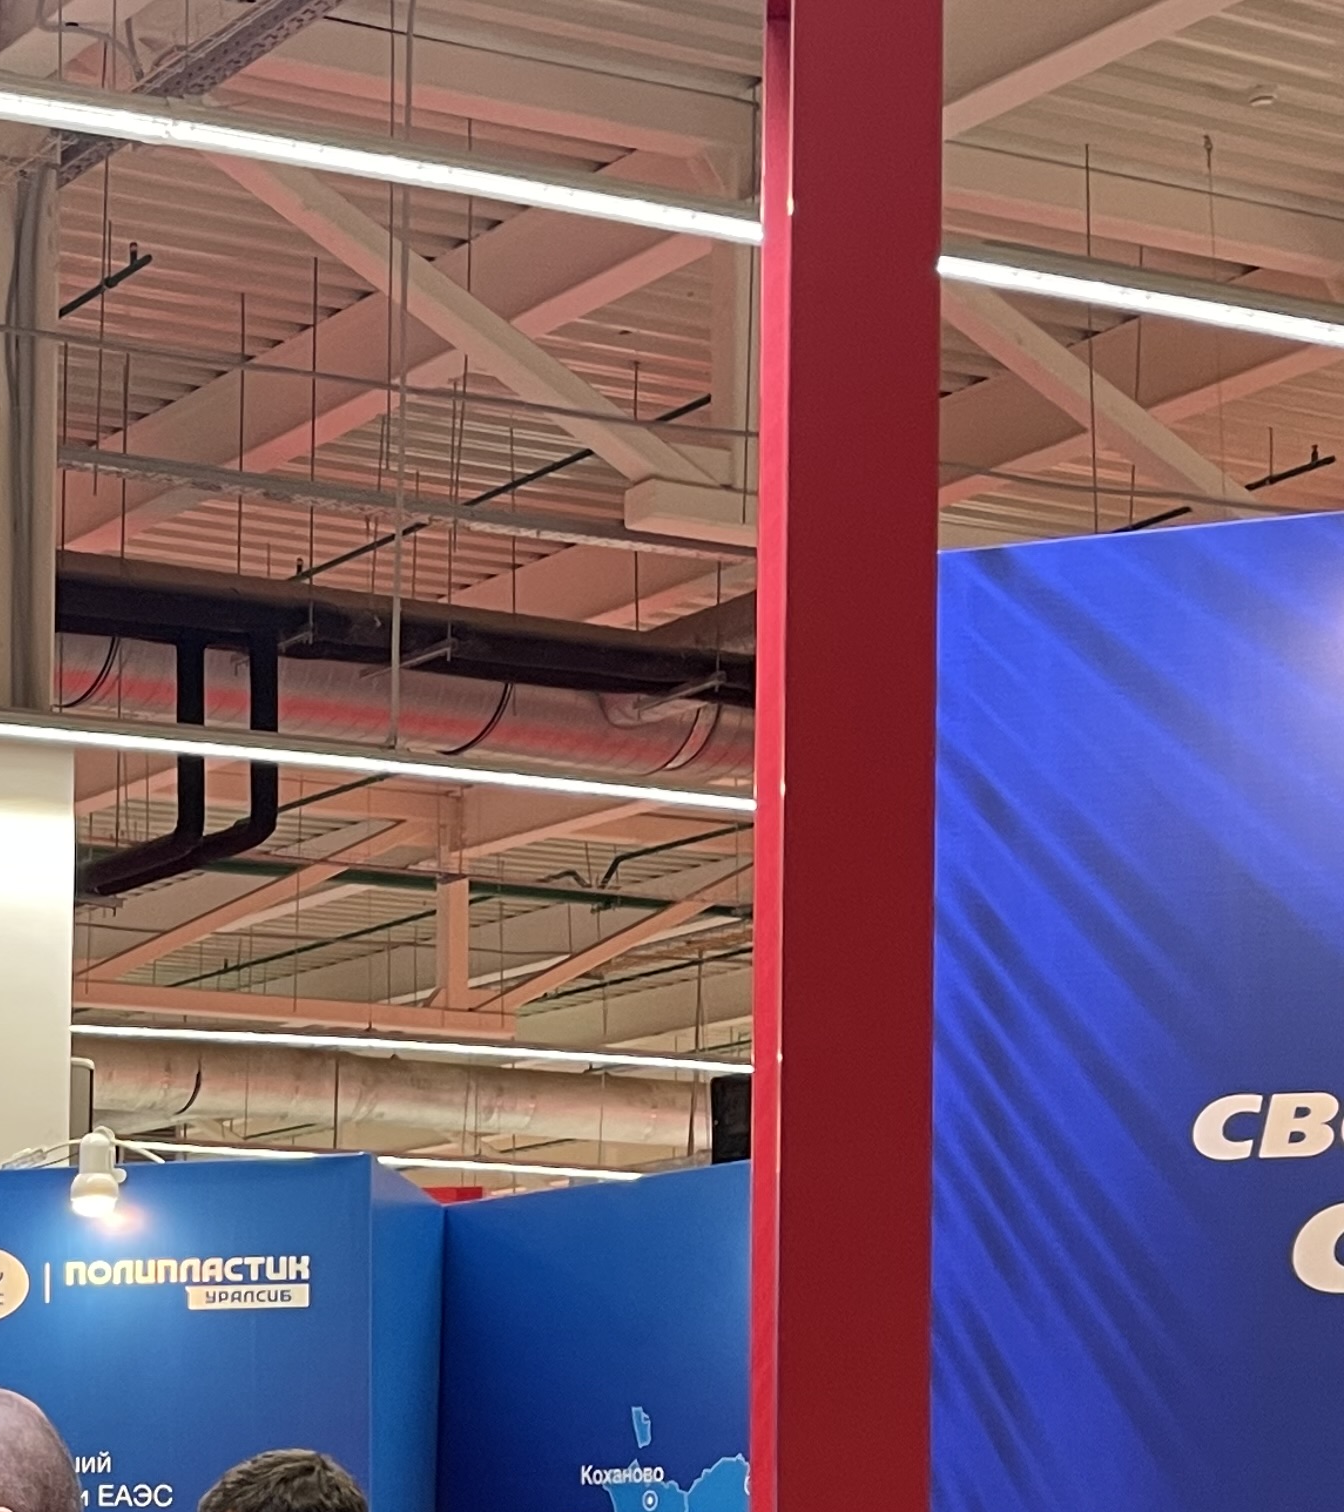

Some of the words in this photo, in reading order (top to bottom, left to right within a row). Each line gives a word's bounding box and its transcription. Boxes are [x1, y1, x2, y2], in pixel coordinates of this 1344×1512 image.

[1192, 1092, 1344, 1161] СВ
[65, 1255, 310, 1286] ПОЛИПЛАСТИК
[204, 1289, 293, 1305] УРАЛСИБ
[581, 1465, 664, 1485] Коханово
[98, 1483, 173, 1508] ЕАЭС
